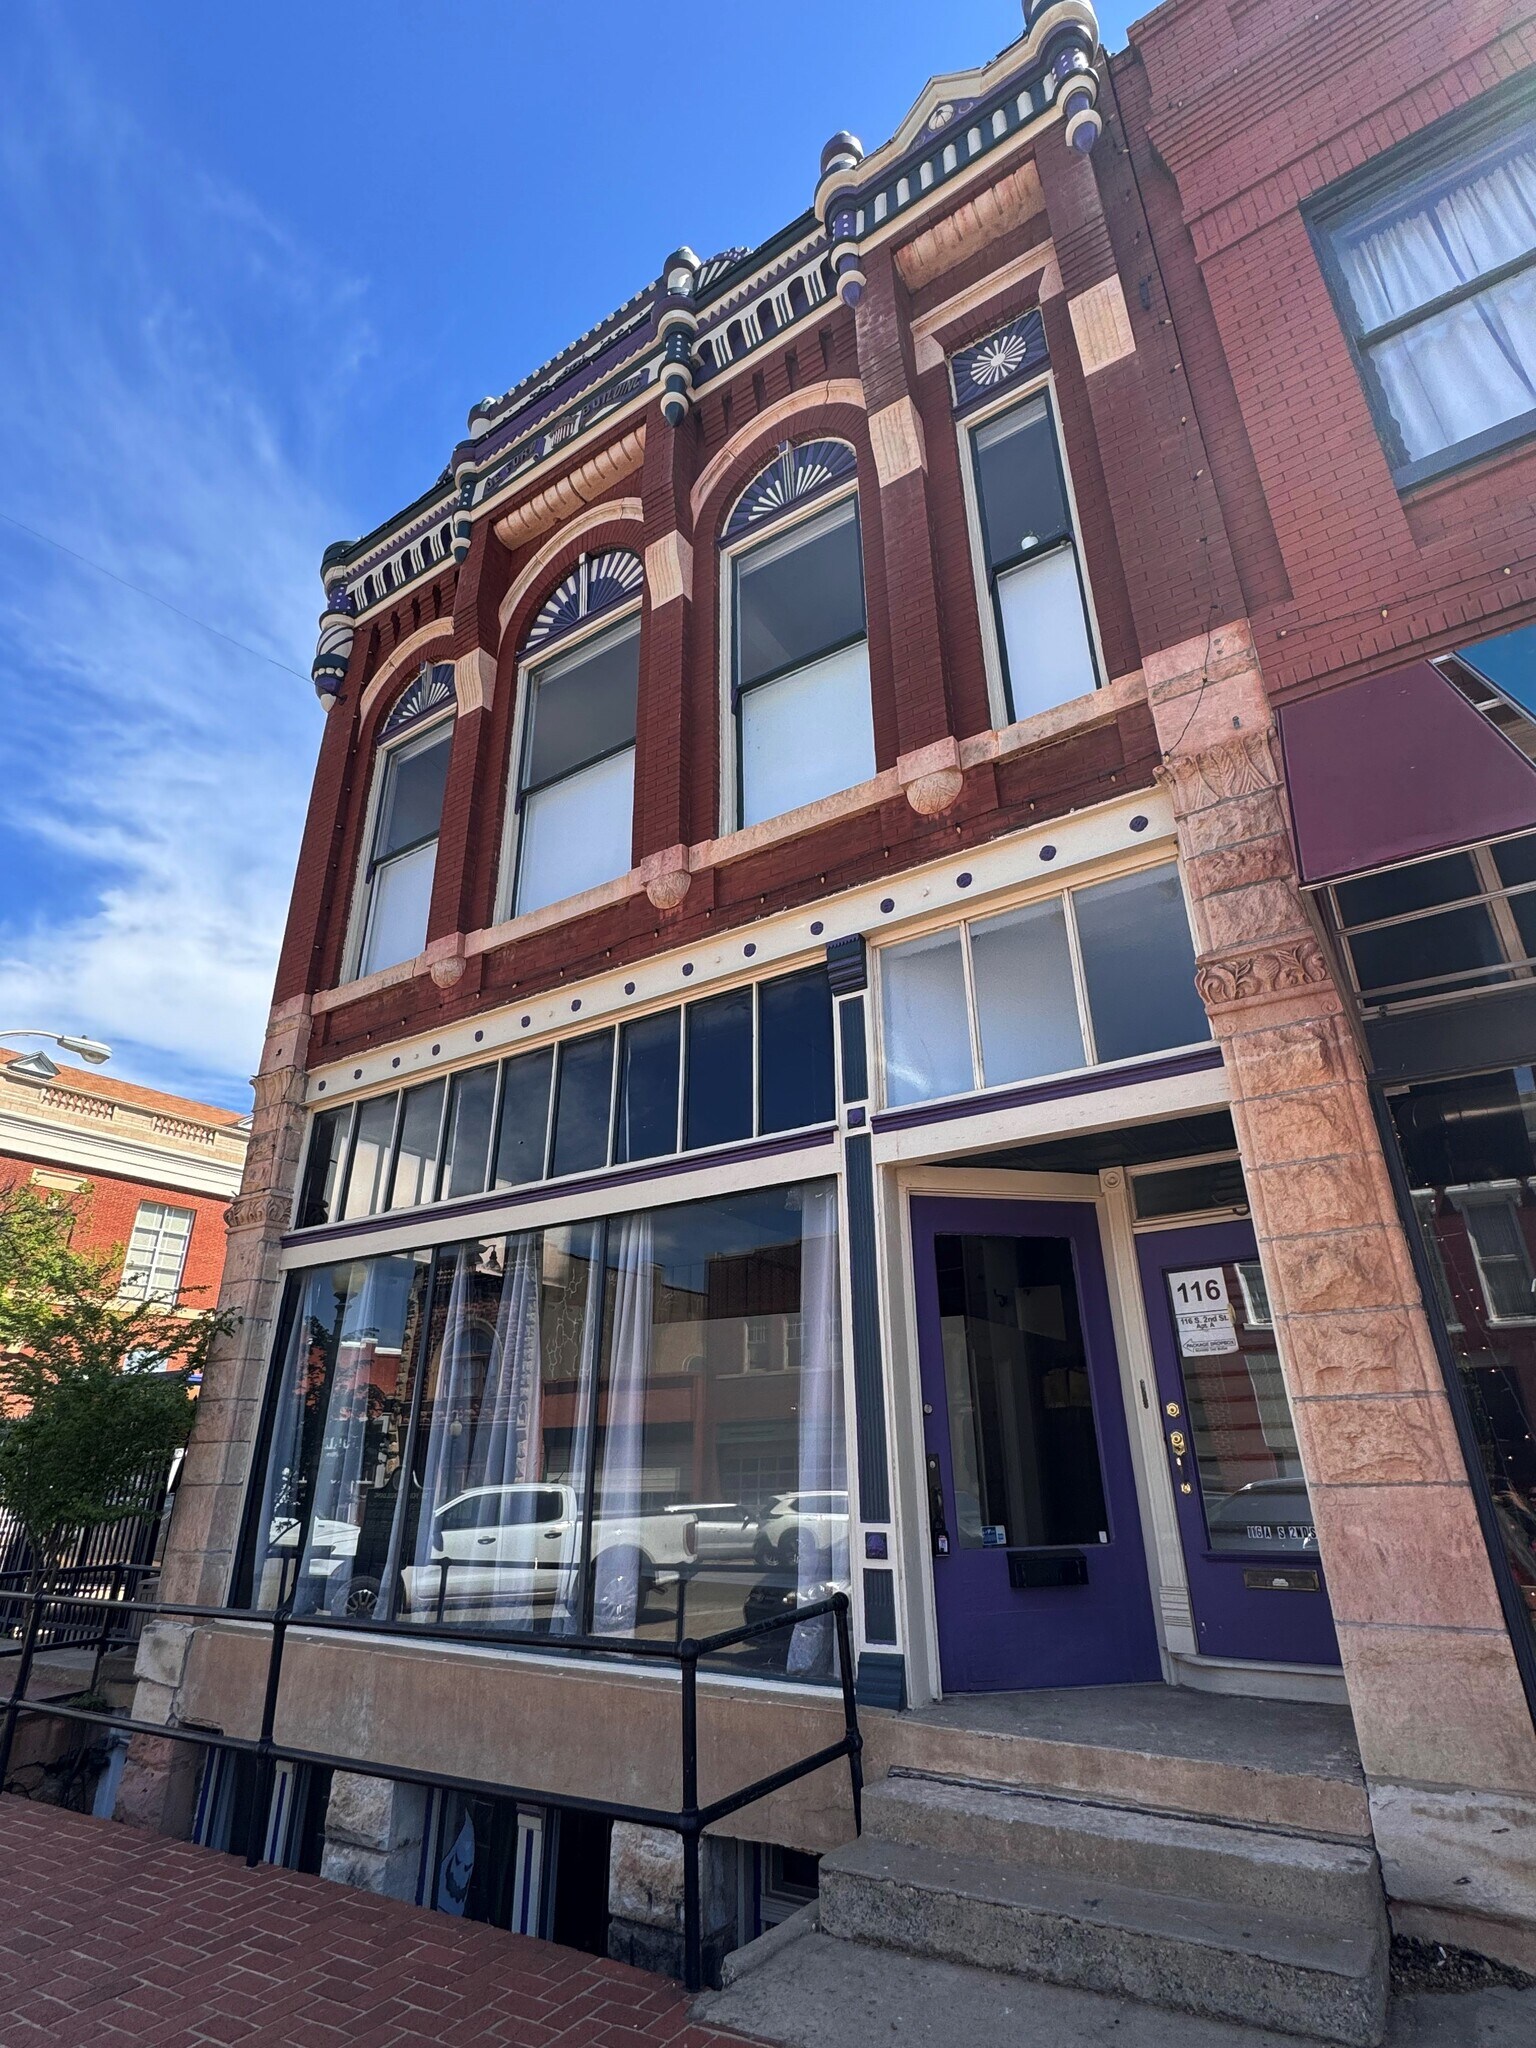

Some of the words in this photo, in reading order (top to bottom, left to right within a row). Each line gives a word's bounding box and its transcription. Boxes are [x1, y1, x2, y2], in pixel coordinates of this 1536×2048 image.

[581, 375, 642, 416] BUILDING
[1177, 1279, 1221, 1303] 116
[1203, 1315, 1217, 1323] 2nd
[1277, 1526, 1285, 1539] S
